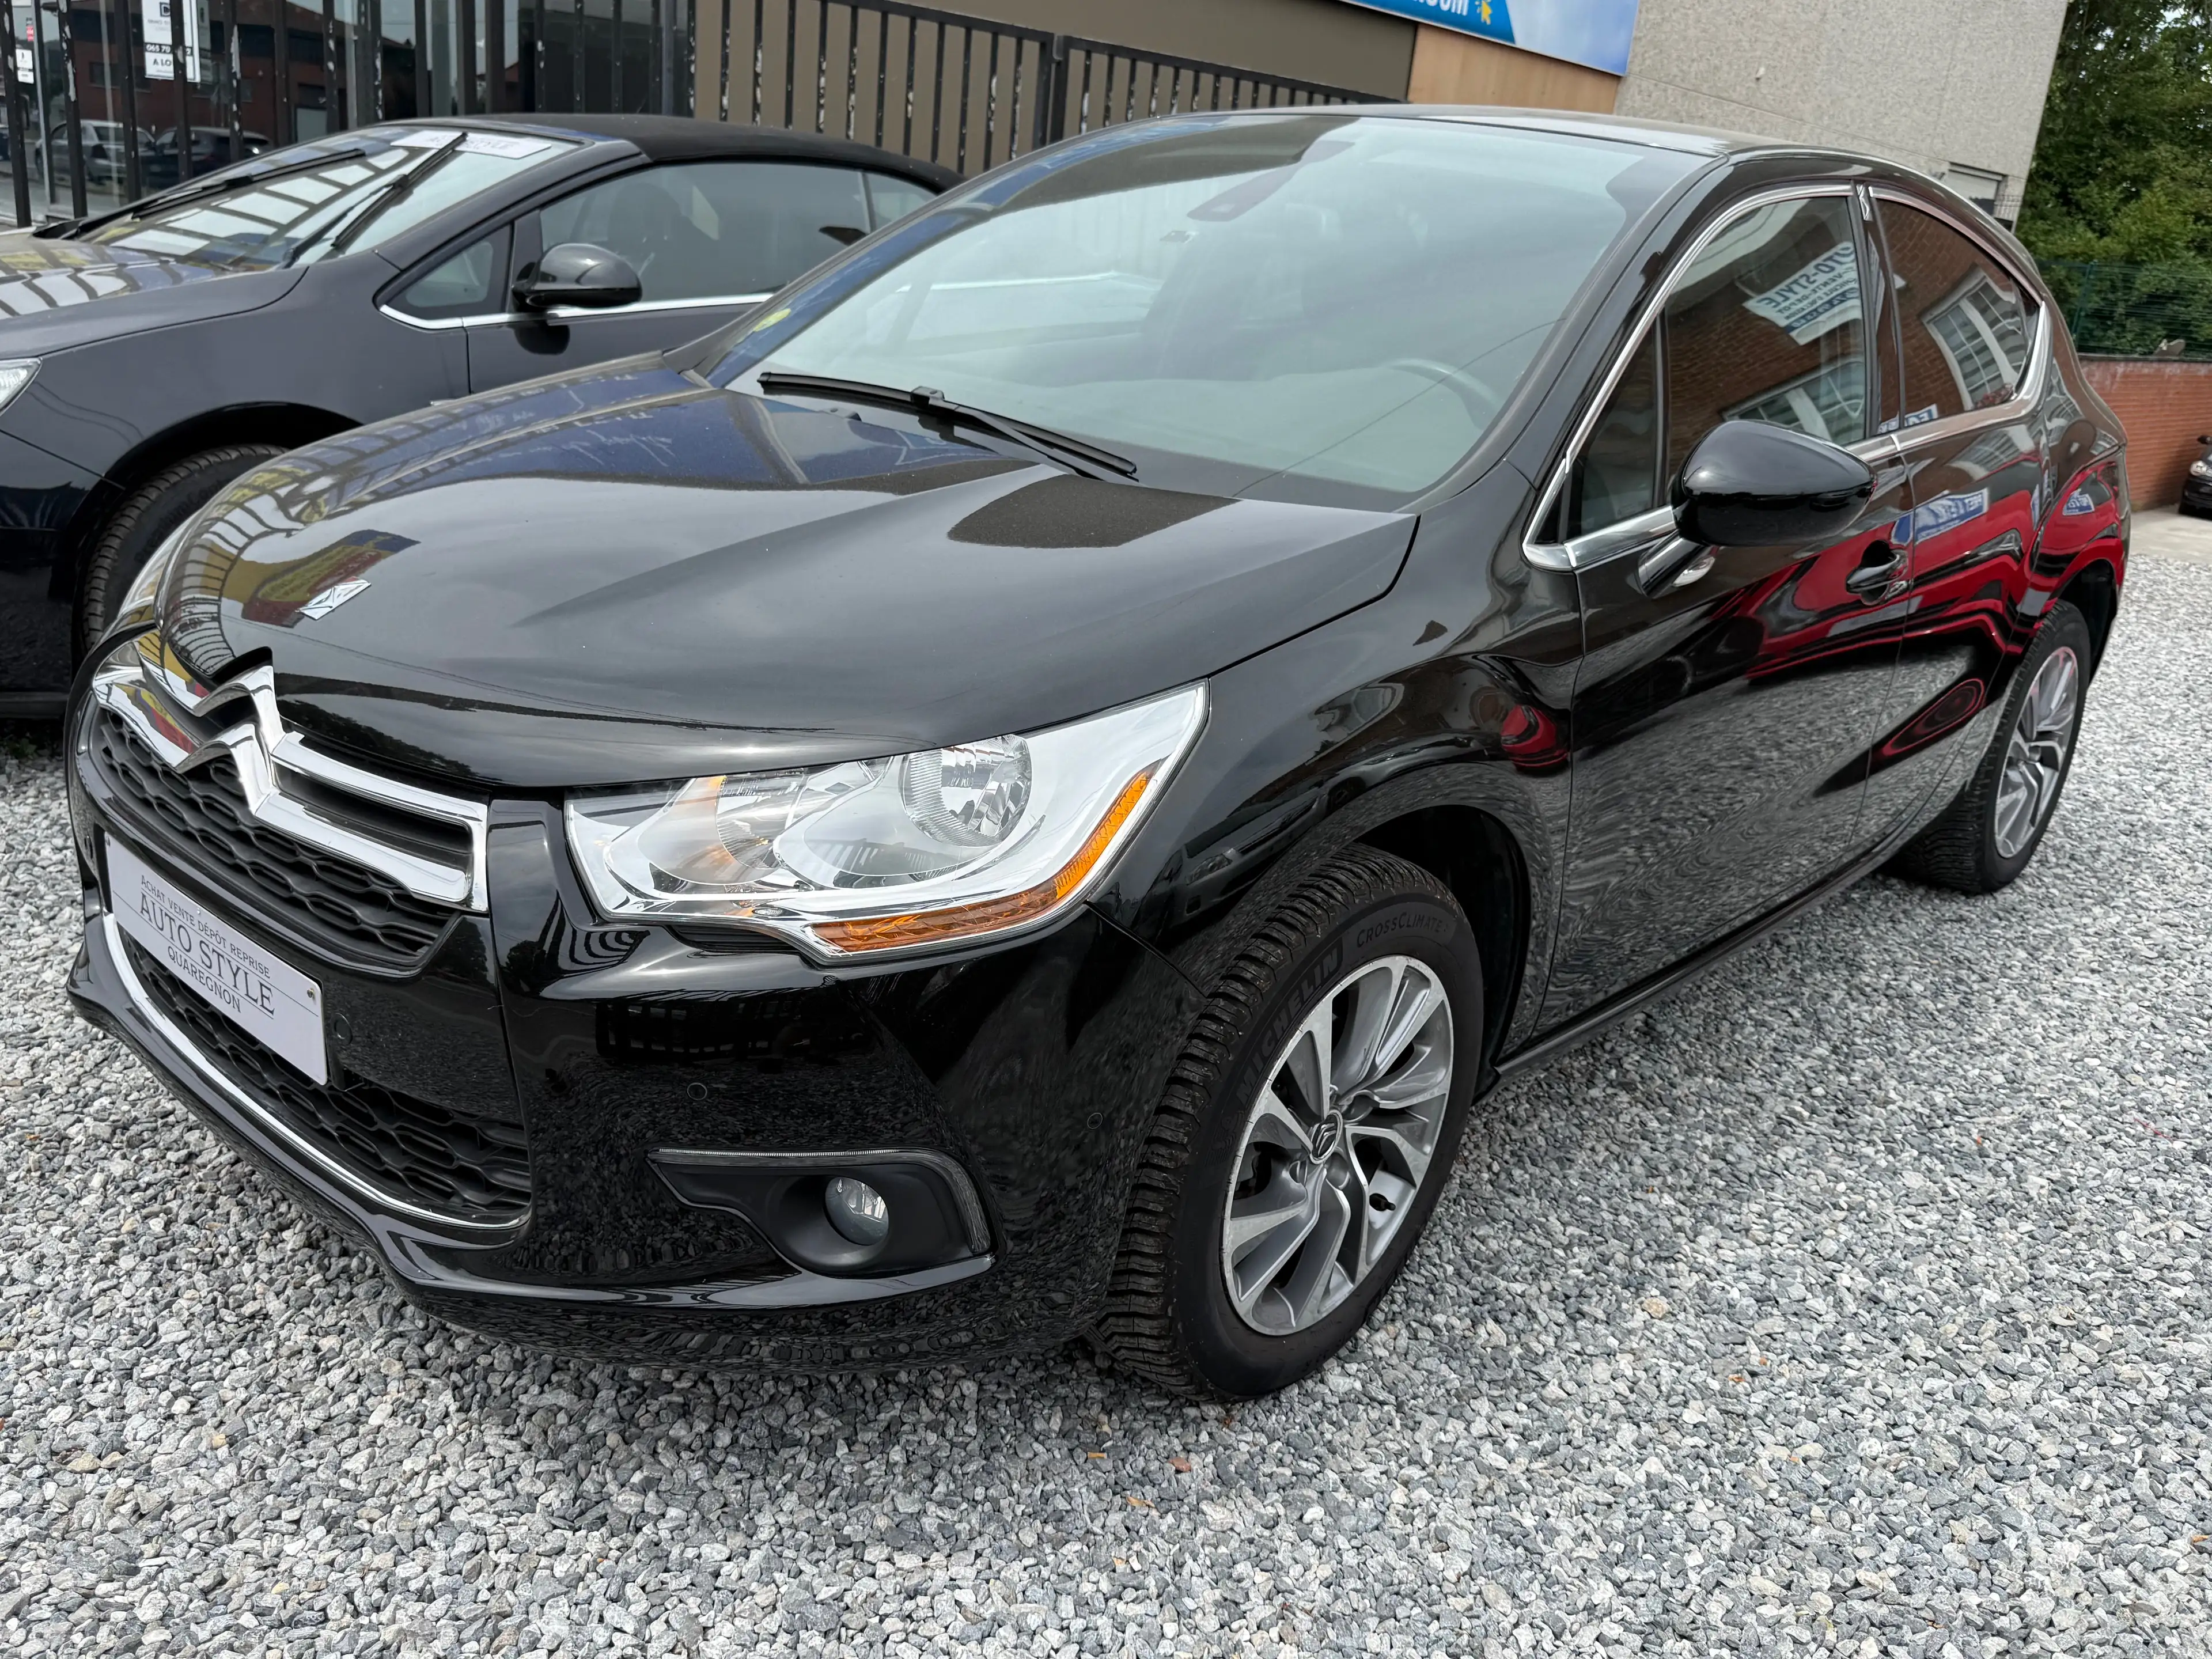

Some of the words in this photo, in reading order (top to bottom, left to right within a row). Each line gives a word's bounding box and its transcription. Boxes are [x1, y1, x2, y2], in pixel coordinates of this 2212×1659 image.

[140, 892, 192, 953] AUTO
[199, 940, 275, 1016] STYLE
[141, 874, 165, 904] ACHAT
[168, 897, 195, 926] VENTE
[198, 922, 226, 949] DÉPÔT
[230, 943, 270, 979] REPRISE
[168, 946, 241, 1013] QUAREGNON
[1236, 947, 1339, 1106] MICHELIN
